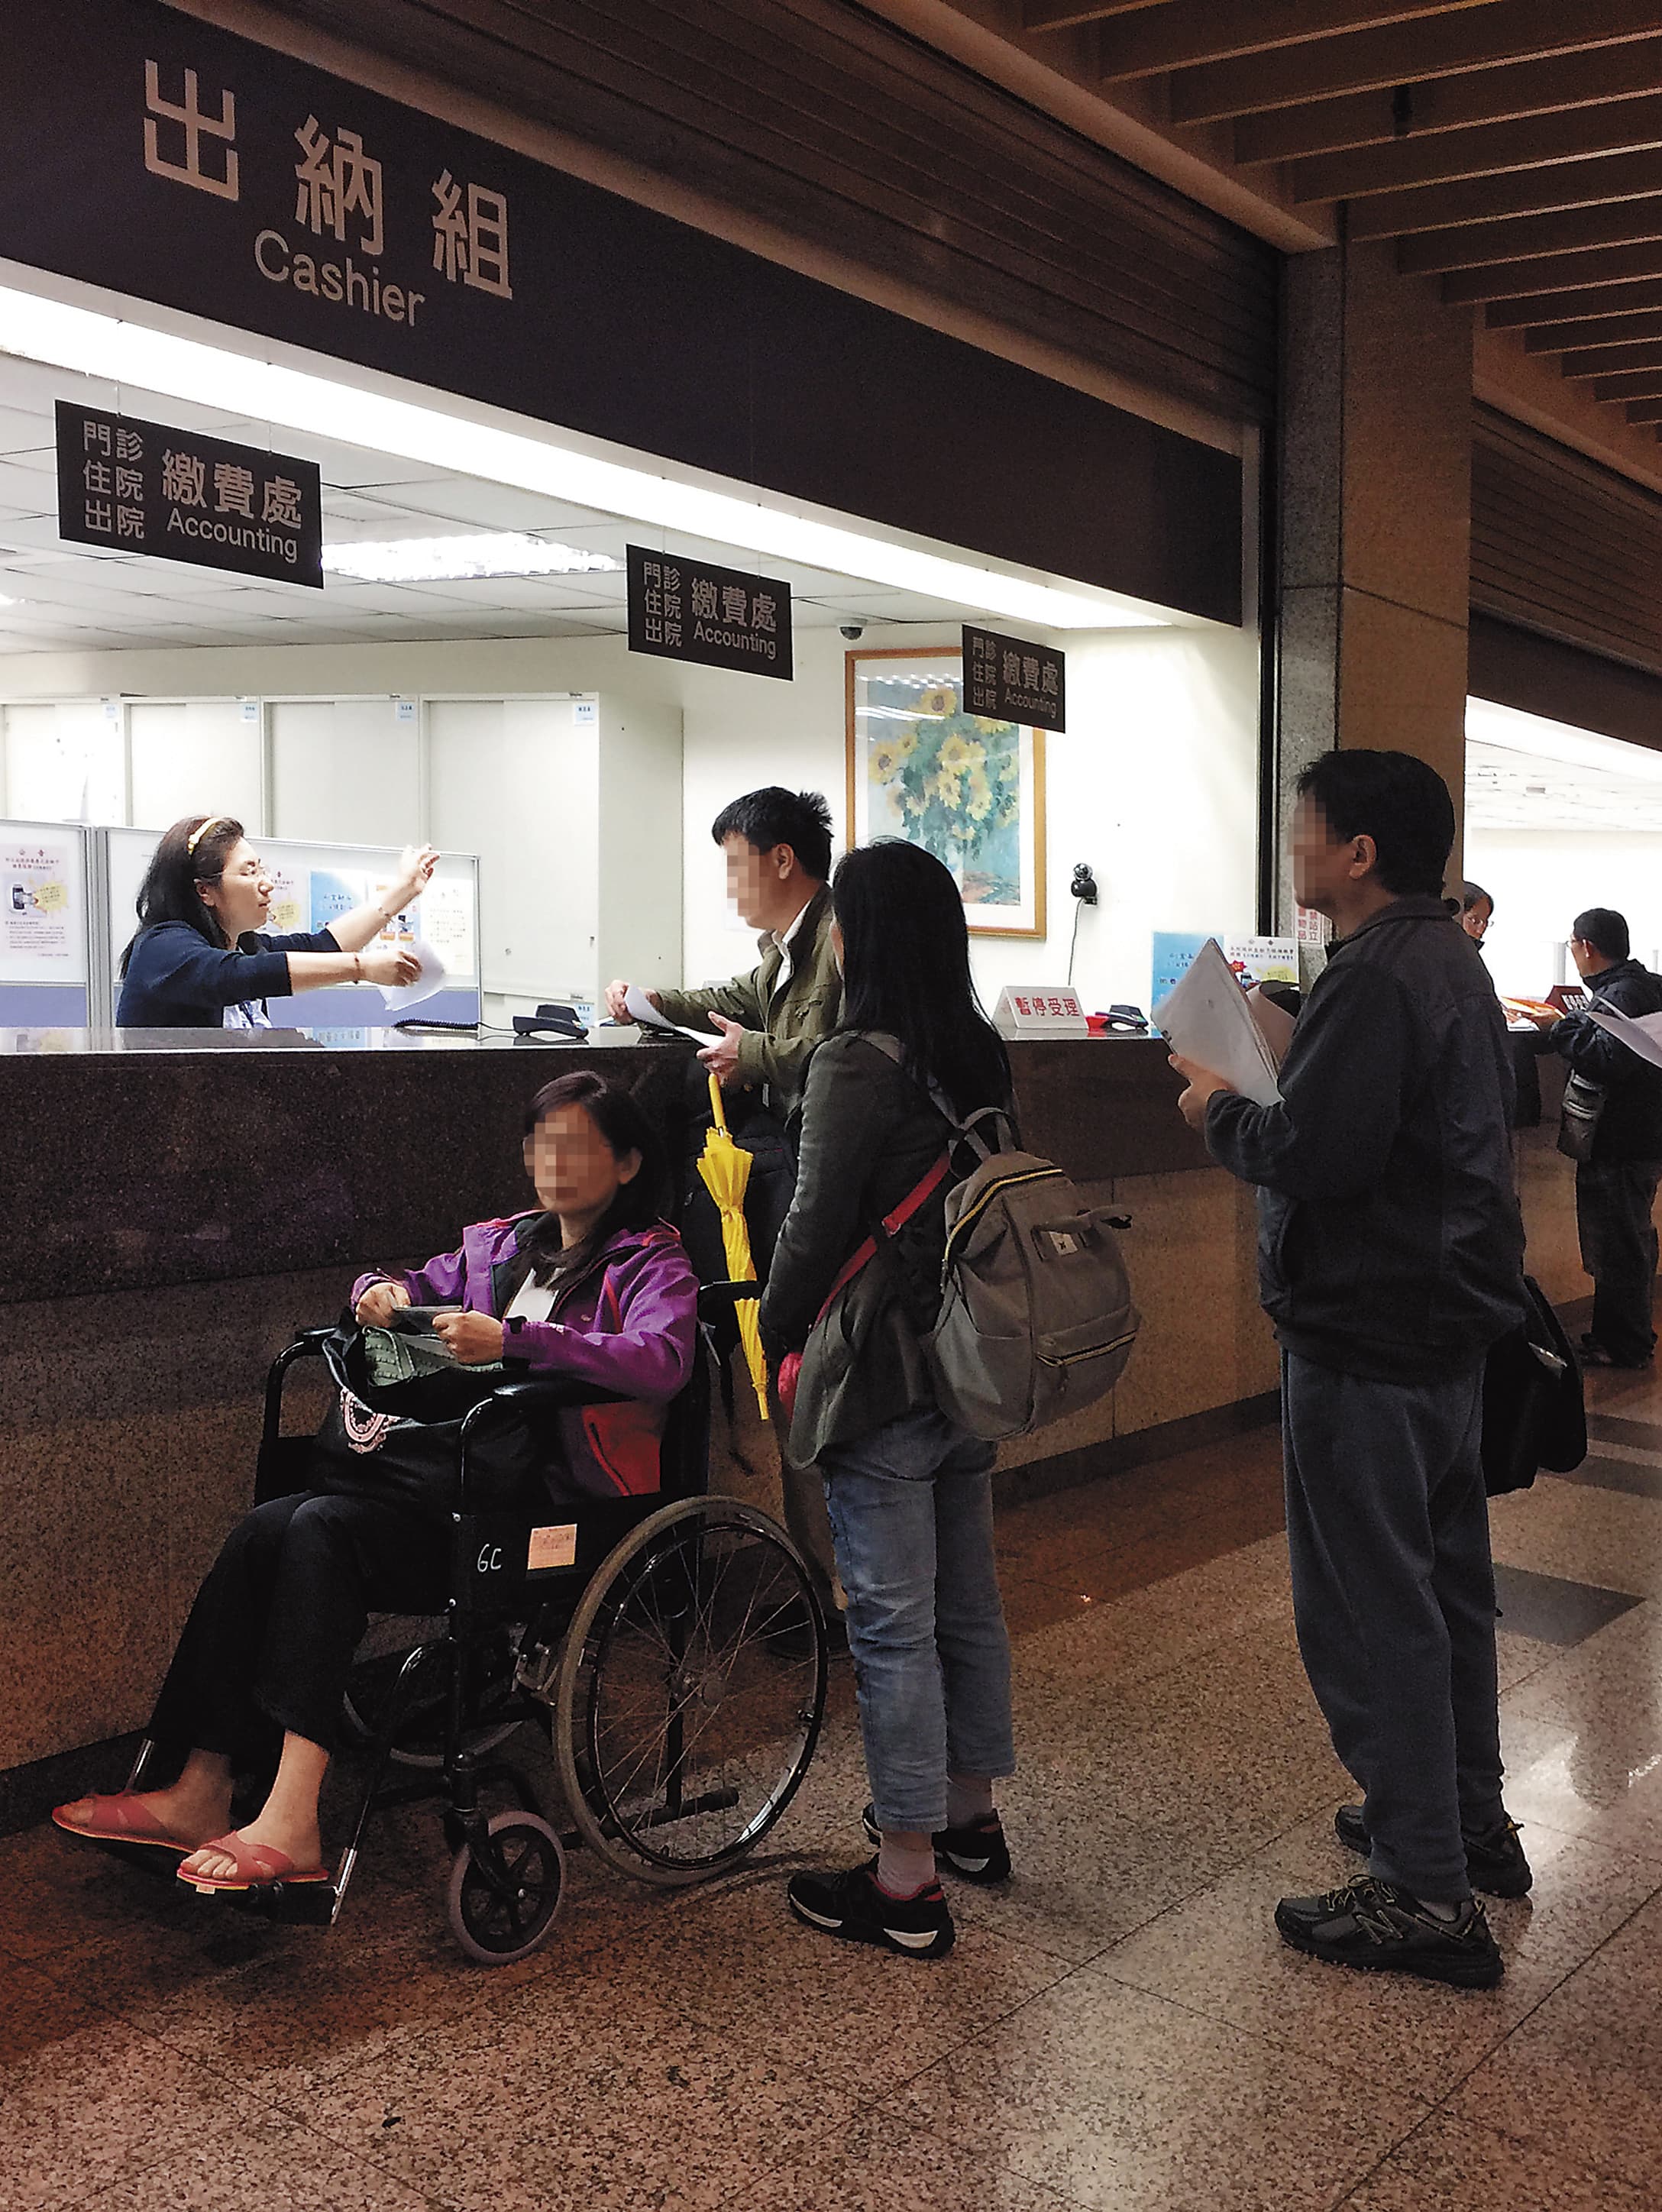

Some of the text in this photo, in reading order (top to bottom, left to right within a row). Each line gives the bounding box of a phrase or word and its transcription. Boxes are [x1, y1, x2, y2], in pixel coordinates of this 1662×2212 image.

[144, 58, 513, 300] 出納組
[254, 229, 425, 328] Cashier
[82, 419, 144, 463] 門診
[82, 459, 144, 502] 住院
[161, 448, 302, 530] 繳費處
[84, 499, 145, 540] 出院
[166, 507, 299, 564] Accounting
[643, 561, 681, 592] 門診
[643, 588, 682, 620] 住院
[690, 577, 778, 634] 繳費處
[645, 617, 683, 648] 出院
[693, 619, 777, 661] Accounting
[1004, 687, 1057, 720] Accounting
[1014, 996, 1081, 1017] 暫停受理
